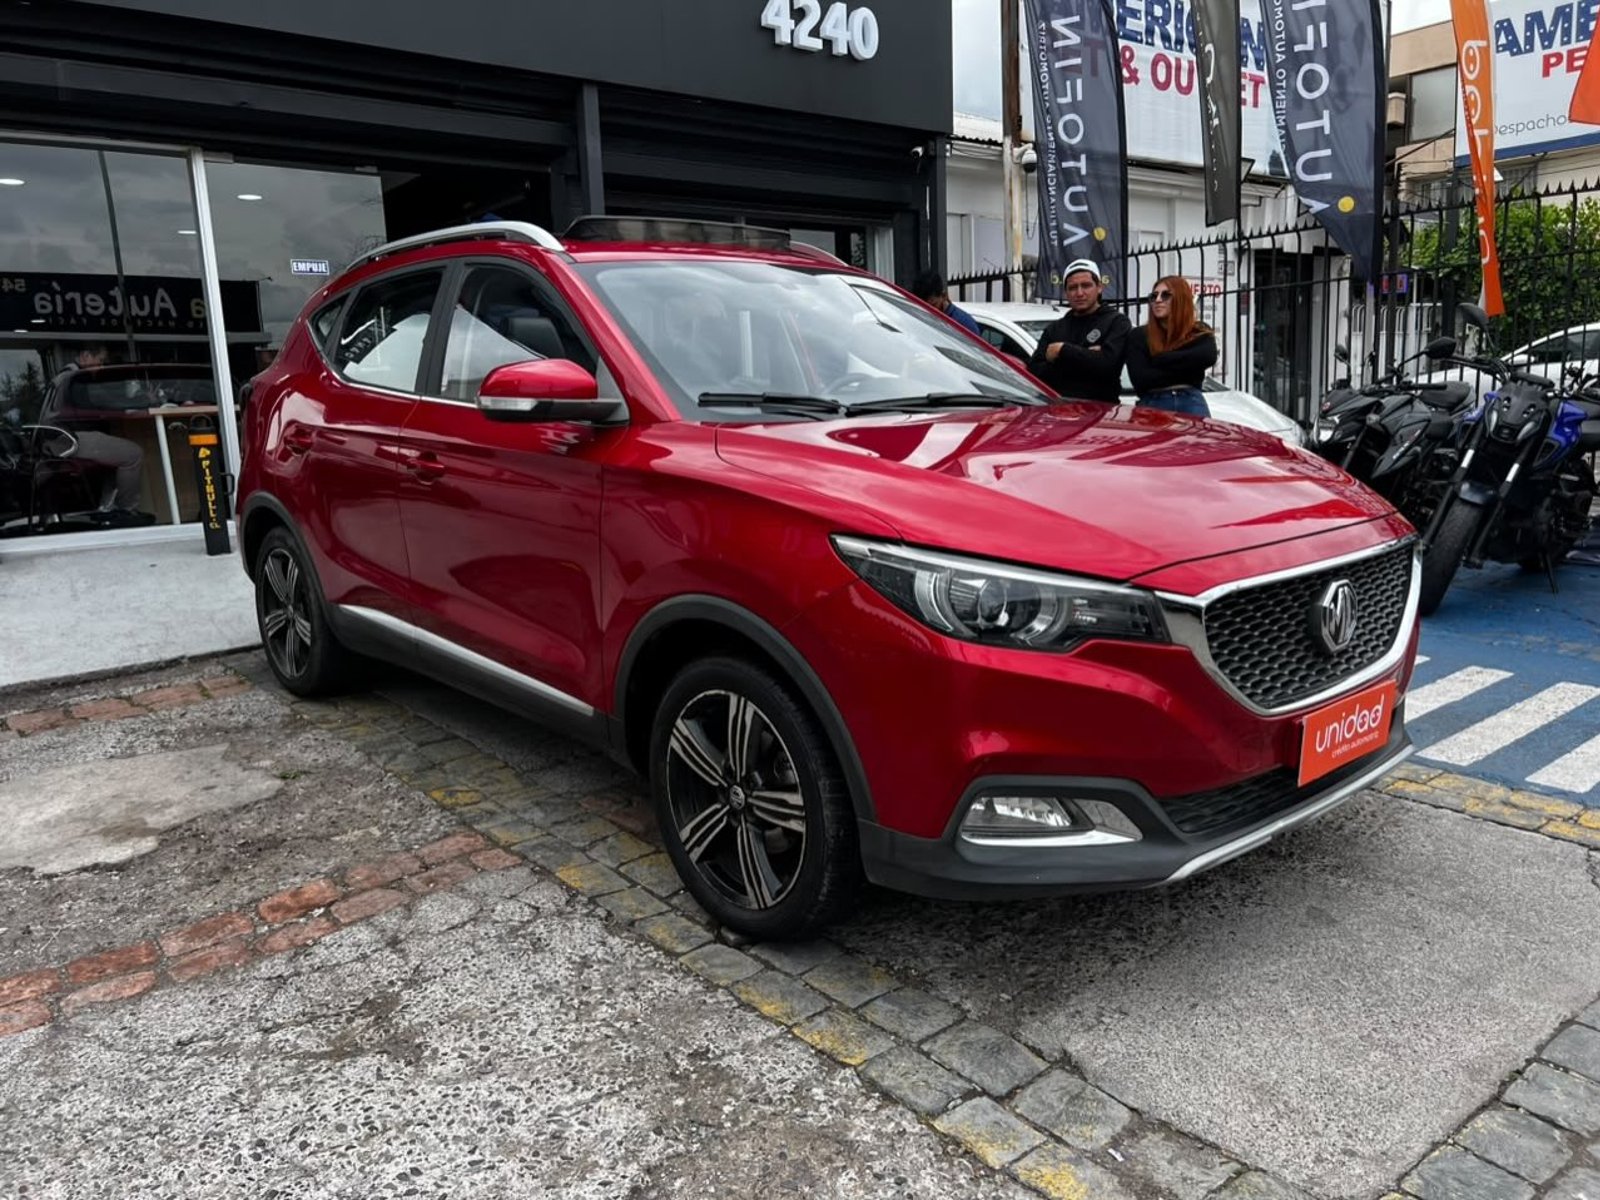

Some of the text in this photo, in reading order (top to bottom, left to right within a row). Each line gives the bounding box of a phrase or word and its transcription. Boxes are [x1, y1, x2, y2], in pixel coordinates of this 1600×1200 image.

[760, 0, 879, 60] 4240
[292, 261, 328, 272] EMPUJE
[1316, 693, 1385, 753] unidad
